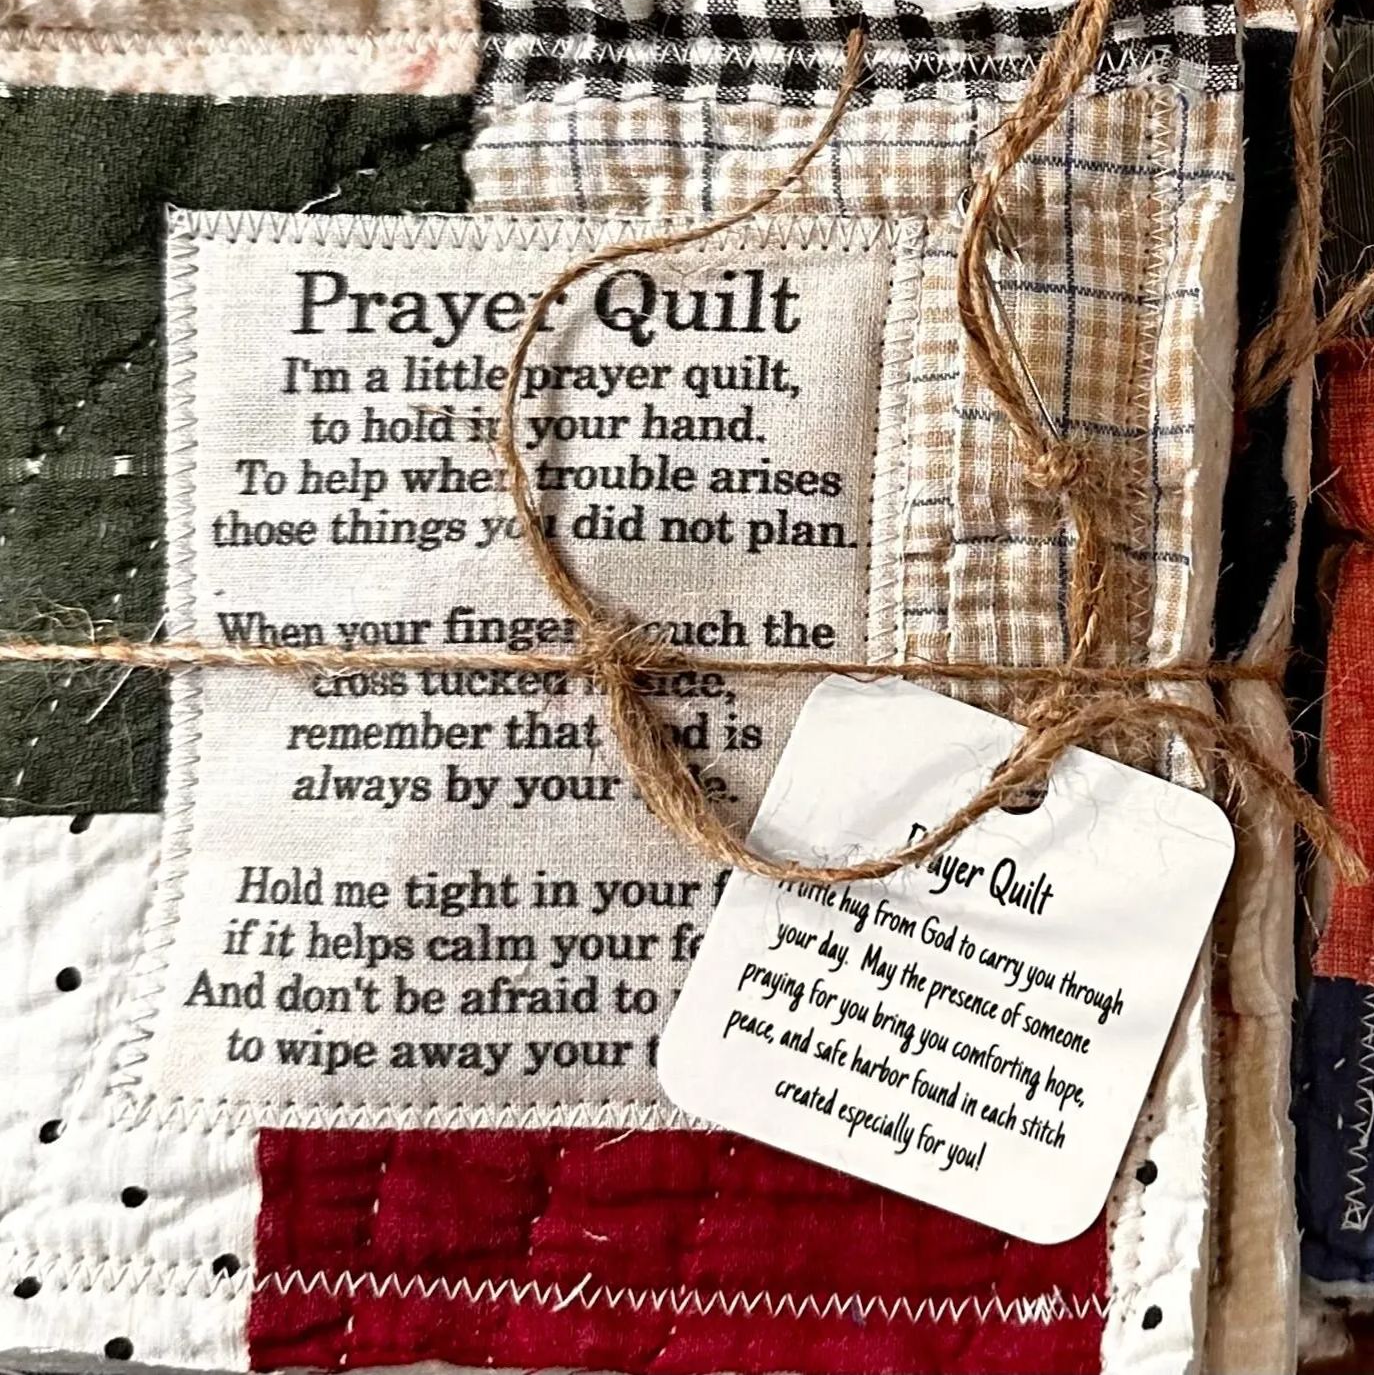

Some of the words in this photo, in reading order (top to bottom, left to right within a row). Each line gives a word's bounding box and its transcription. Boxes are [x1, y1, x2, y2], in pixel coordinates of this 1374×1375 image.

[594, 266, 801, 347] Quilt
[280, 356, 350, 396] I'm
[365, 366, 389, 394] a
[402, 354, 507, 393] little
[518, 362, 669, 401] prayer
[683, 356, 801, 400] quilt,
[211, 509, 318, 548] those
[329, 511, 467, 551] things
[573, 505, 645, 543] did
[657, 509, 734, 545] not
[746, 509, 860, 554] plan.
[291, 764, 433, 804] always
[446, 763, 502, 810] by
[512, 770, 621, 810] your
[989, 857, 1053, 914] Quilt
[183, 969, 265, 1011] And
[276, 975, 380, 1012] don't
[399, 975, 446, 1014] be
[460, 975, 601, 1015] afraid
[615, 982, 659, 1014] to
[722, 1009, 773, 1043] peace,
[779, 1027, 814, 1053] and
[813, 1038, 847, 1066] safe
[850, 1044, 909, 1087] harbor
[911, 1068, 960, 1108] found
[960, 1092, 977, 1116] in
[980, 1102, 1016, 1130] each
[1020, 1114, 1067, 1150] stitch
[774, 1080, 838, 1115] created
[838, 1104, 914, 1154] especially
[916, 1123, 945, 1154] for
[939, 1142, 986, 1171] you!
